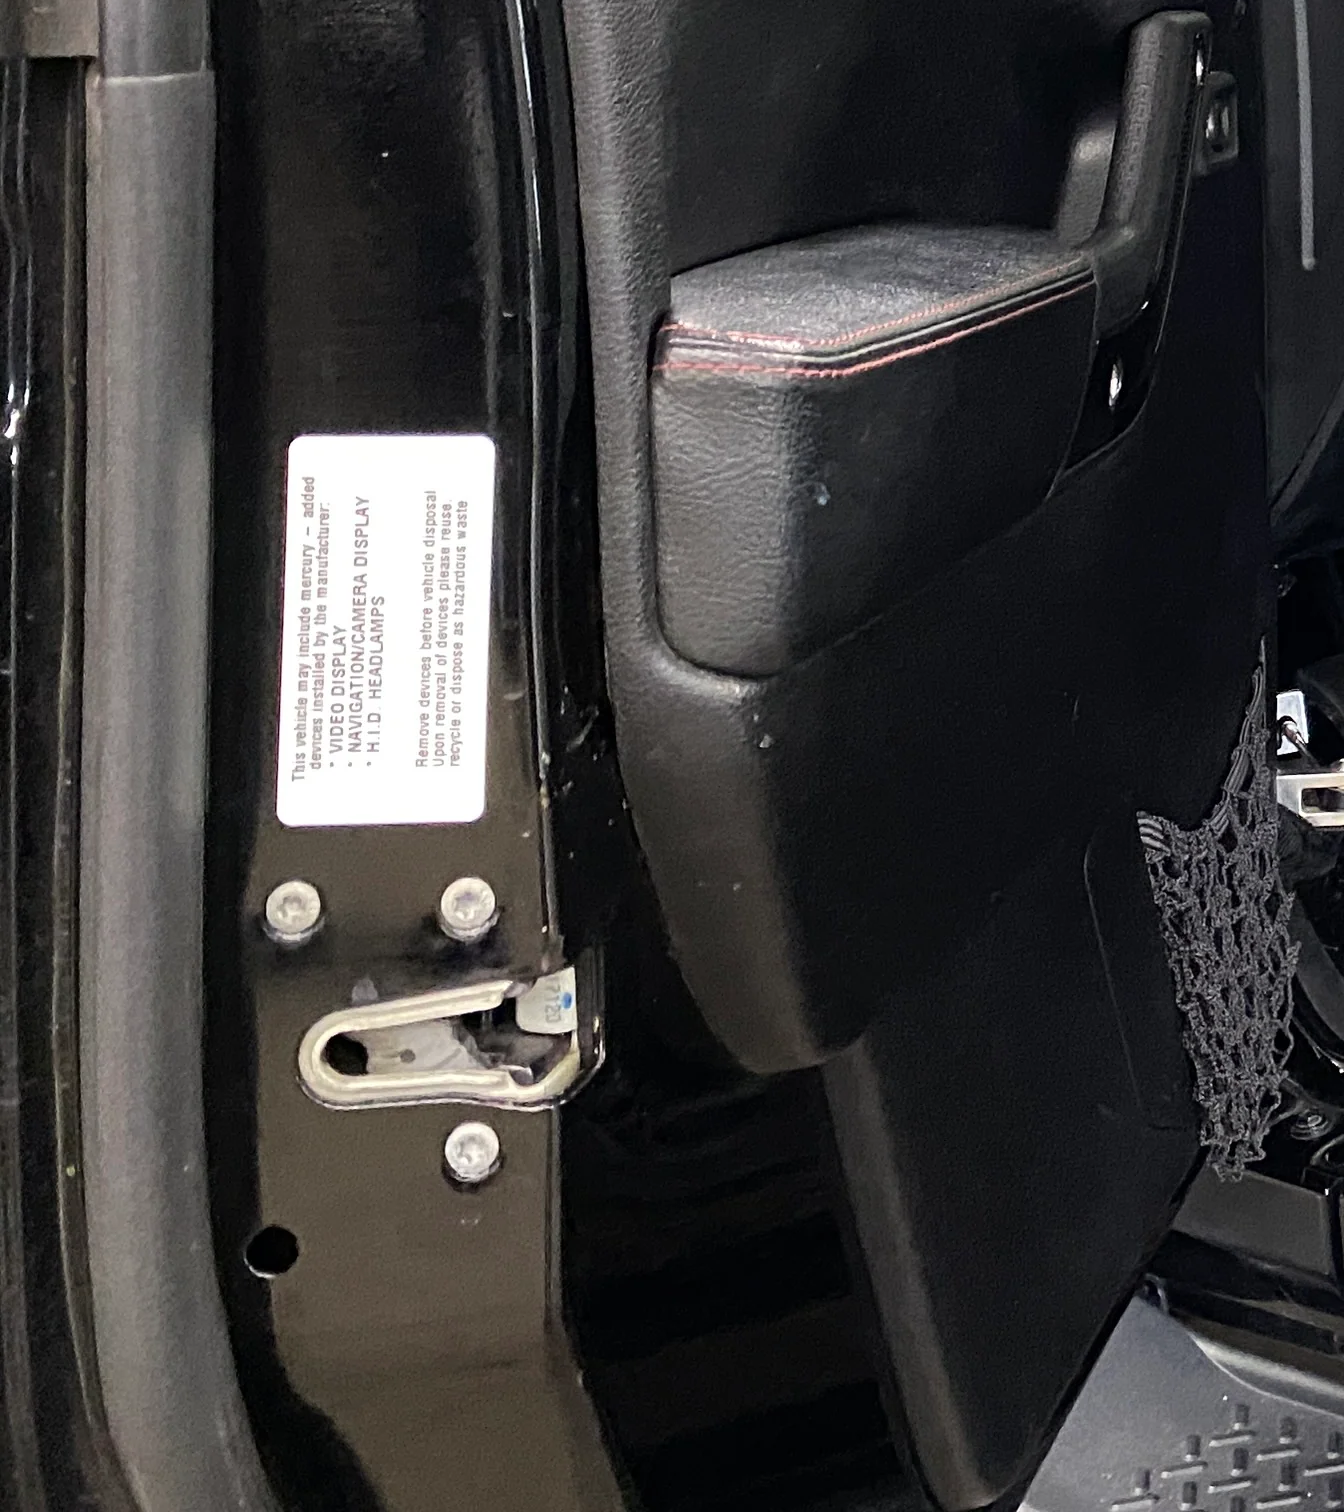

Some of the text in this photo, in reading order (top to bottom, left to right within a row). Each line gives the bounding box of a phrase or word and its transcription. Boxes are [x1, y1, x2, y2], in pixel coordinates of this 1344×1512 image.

[300, 476, 315, 518] added
[301, 544, 315, 601] mercury
[437, 547, 452, 591] please
[296, 606, 311, 658] include
[313, 604, 327, 626] the
[313, 631, 329, 647] by
[347, 496, 370, 753] NAVIGATION/CAMERA DISPLAY
[415, 490, 439, 768] Remove devices before vehicle disposal
[435, 597, 449, 649] devices
[448, 500, 468, 767] recycle or dispose as hazardous waste
[368, 596, 385, 700] HEADLAMPS
[434, 653, 448, 666] of
[298, 663, 311, 692] may
[310, 653, 326, 712] installed
[329, 625, 347, 754] VIDEO DISPLAY
[433, 672, 447, 727] removal
[293, 697, 308, 748] vehicle
[309, 718, 324, 770] devices
[291, 752, 306, 782] This
[432, 732, 446, 767] Upon
